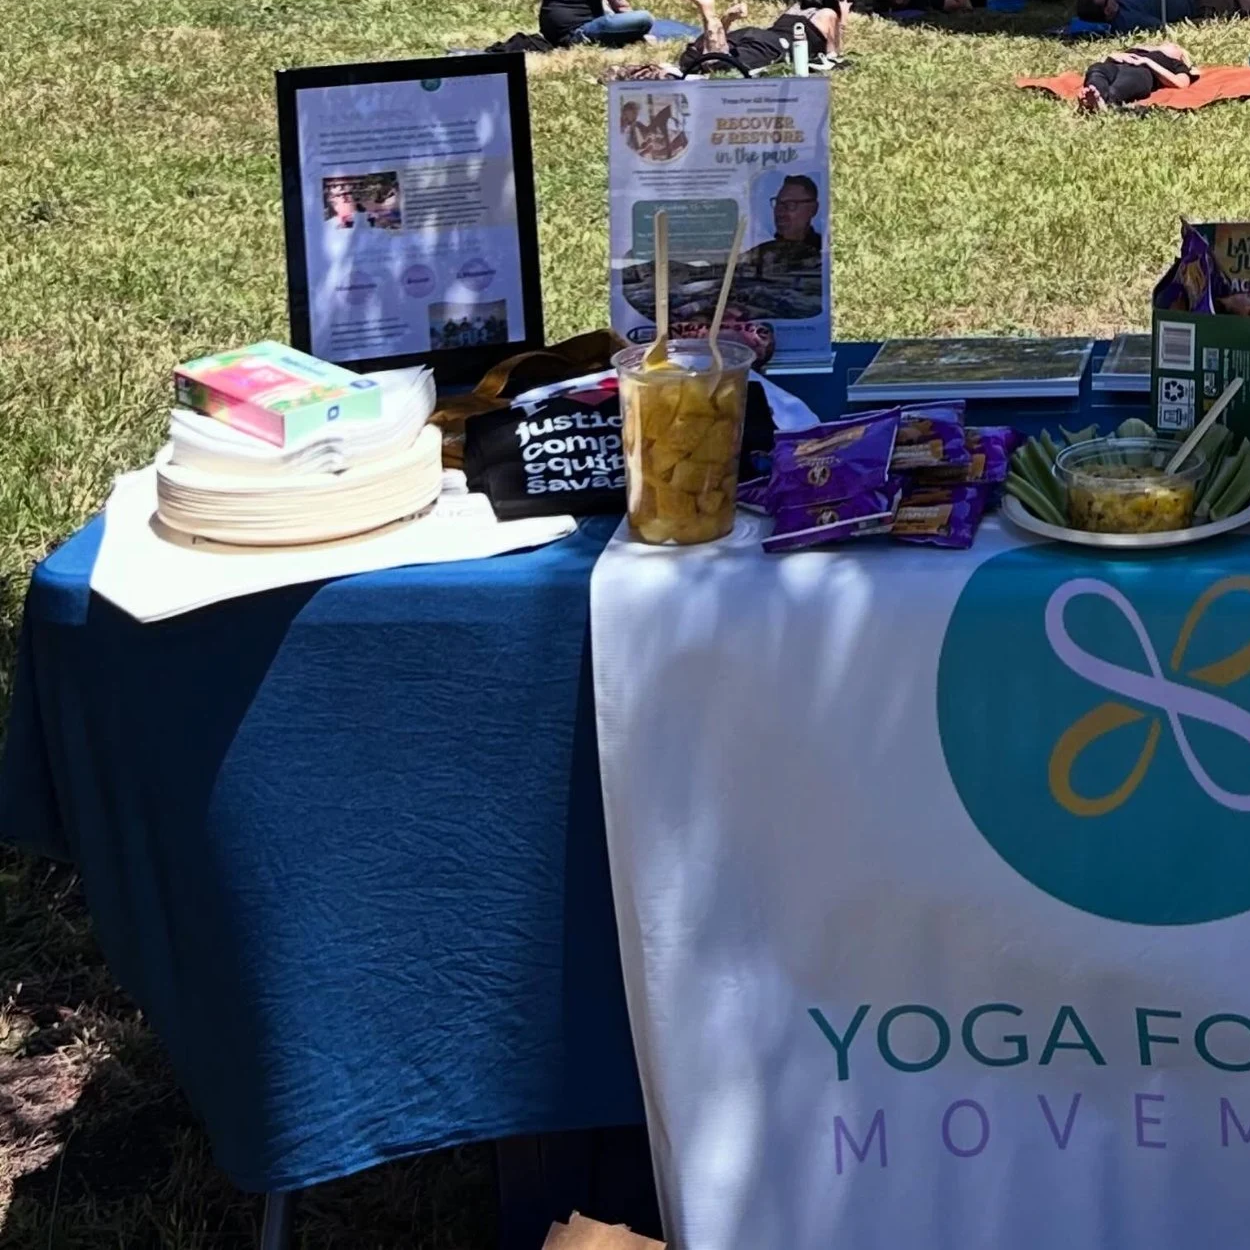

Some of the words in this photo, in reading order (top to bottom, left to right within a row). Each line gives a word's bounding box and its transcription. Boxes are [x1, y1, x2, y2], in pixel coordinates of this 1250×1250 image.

[716, 116, 795, 130] RECOVER
[711, 132, 726, 145] &
[728, 130, 805, 145] RESTORE
[715, 148, 733, 164] in
[735, 147, 760, 164] the
[762, 147, 799, 167] park
[515, 411, 624, 448] justic
[522, 434, 622, 462] comp
[524, 454, 625, 477] equit
[807, 1002, 1106, 1082] YOGA
